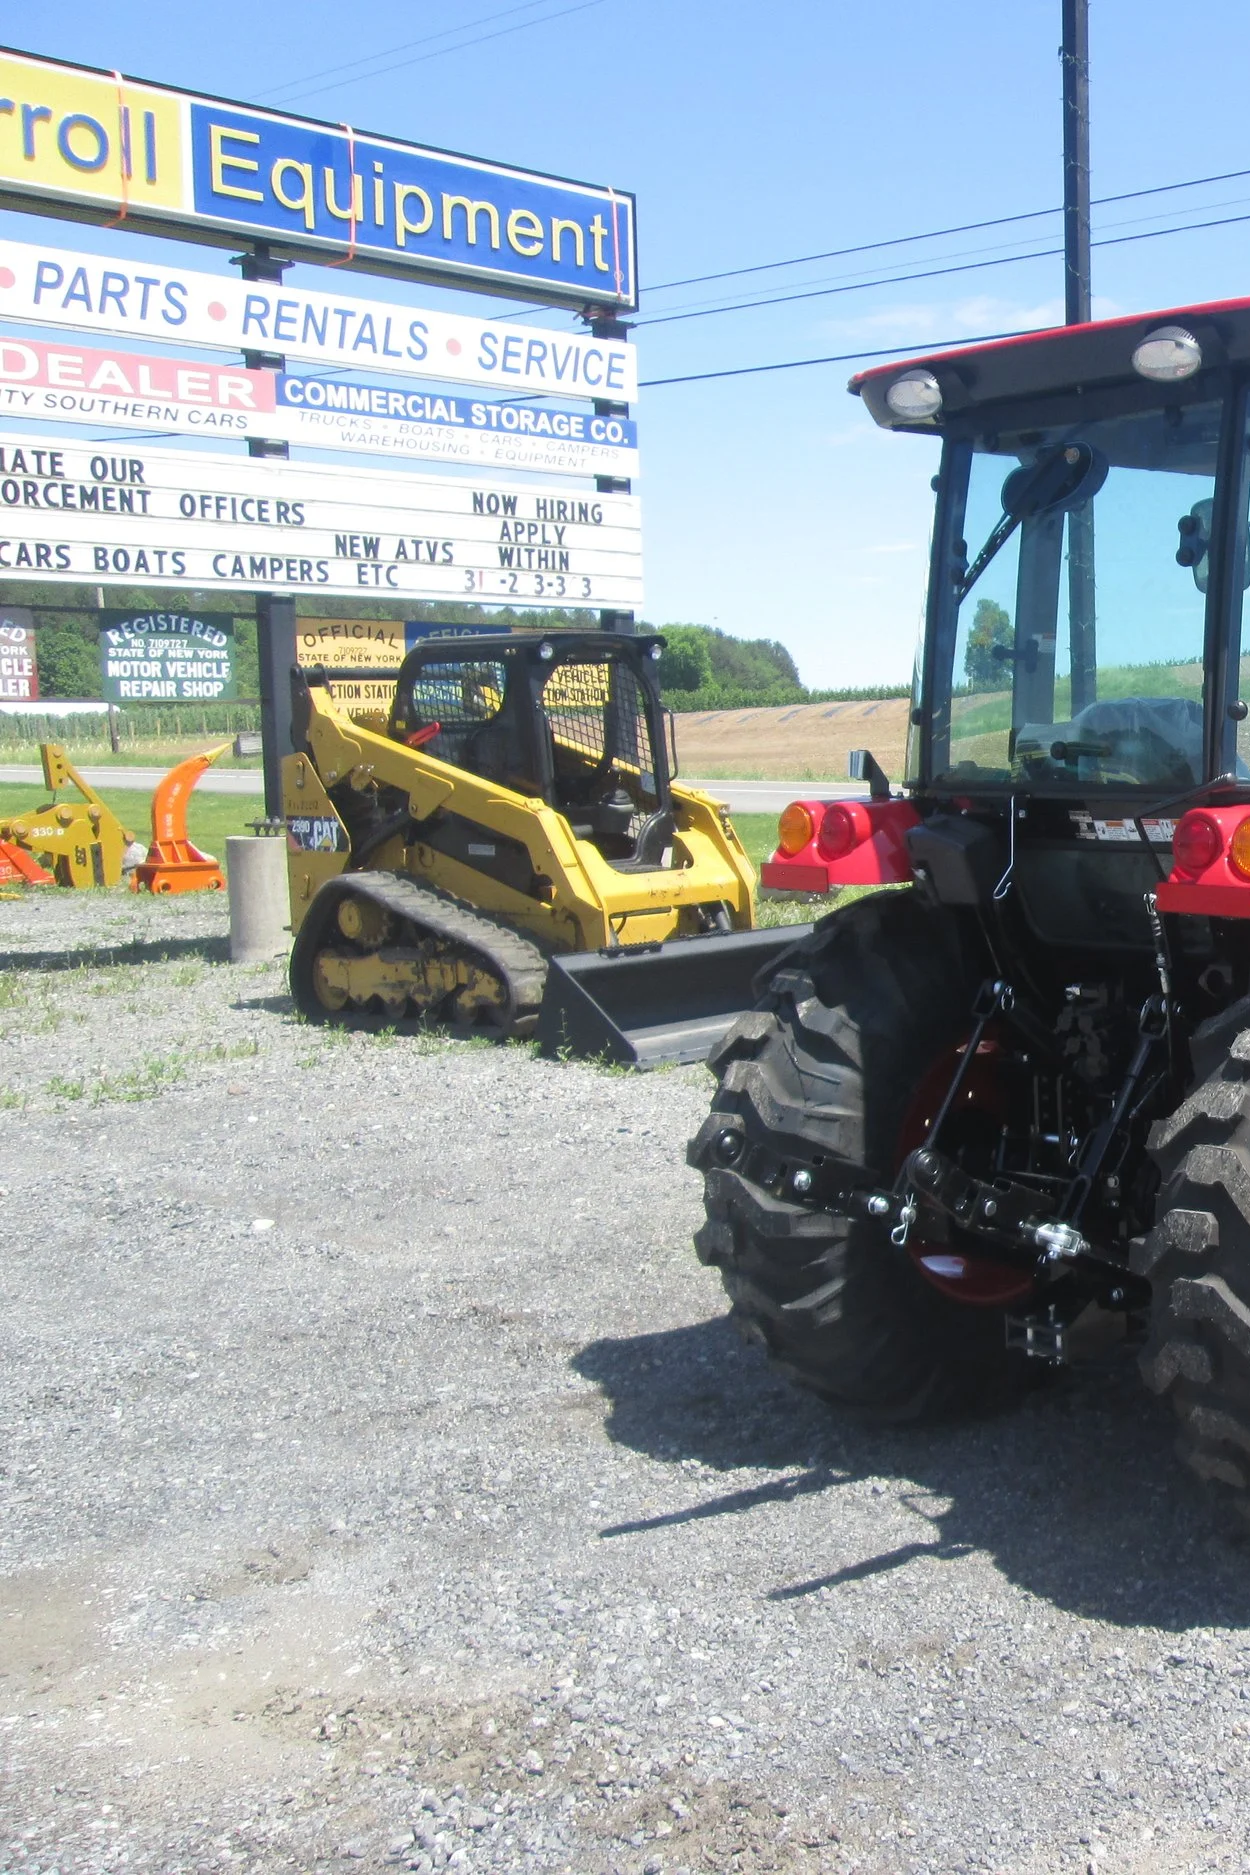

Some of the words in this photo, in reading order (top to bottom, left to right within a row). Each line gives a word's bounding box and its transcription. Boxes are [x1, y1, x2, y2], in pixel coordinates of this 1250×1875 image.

[209, 124, 609, 271] Equipment
[33, 260, 188, 325] PARTS
[242, 294, 429, 361] RENTALS
[478, 332, 625, 390] SERVICE
[0, 342, 257, 408] DEALER
[44, 393, 178, 422] SOUTHERN
[188, 410, 248, 430] CARS
[284, 379, 464, 424] COMMERCIAL
[471, 403, 584, 438] STORAGE
[591, 420, 629, 444] CO.
[299, 411, 372, 430] TRUCKS
[399, 423, 455, 439] BOATS
[480, 432, 522, 447] CARS
[547, 441, 619, 459] CAMPERS
[341, 431, 470, 455] WAREHOUSING
[495, 448, 586, 468] EQUIPMENT
[91, 456, 145, 484] OUR
[1, 479, 151, 513] ORCEMENT
[180, 493, 305, 525] OFFICERS
[472, 491, 518, 516] NOW
[536, 498, 602, 524] HIRING
[500, 520, 566, 546] APPLY
[0, 541, 71, 569] CARS
[94, 546, 186, 576] BOATS
[212, 553, 329, 583] CAMPERS
[357, 563, 398, 587] ETC
[335, 534, 381, 559] NEW
[395, 539, 453, 565] ATVS
[498, 546, 569, 571] WITHIN
[107, 614, 227, 647] REGISTERED
[303, 624, 399, 650] OFFICIAL
[0, 645, 28, 656] ORK
[108, 648, 144, 658] STATE
[151, 649, 164, 659] OF
[168, 649, 196, 659] NEW
[199, 650, 228, 660] YORK
[299, 653, 329, 662] STATE
[333, 654, 347, 662] OF
[350, 654, 371, 663] NEW
[376, 654, 402, 663] YORK
[108, 660, 162, 678] MOTOR
[166, 661, 230, 679] VEHICLE
[120, 681, 177, 697] REPAIR
[182, 681, 223, 698] SHOP
[32, 826, 53, 838] 330
[314, 820, 338, 852] CAT
